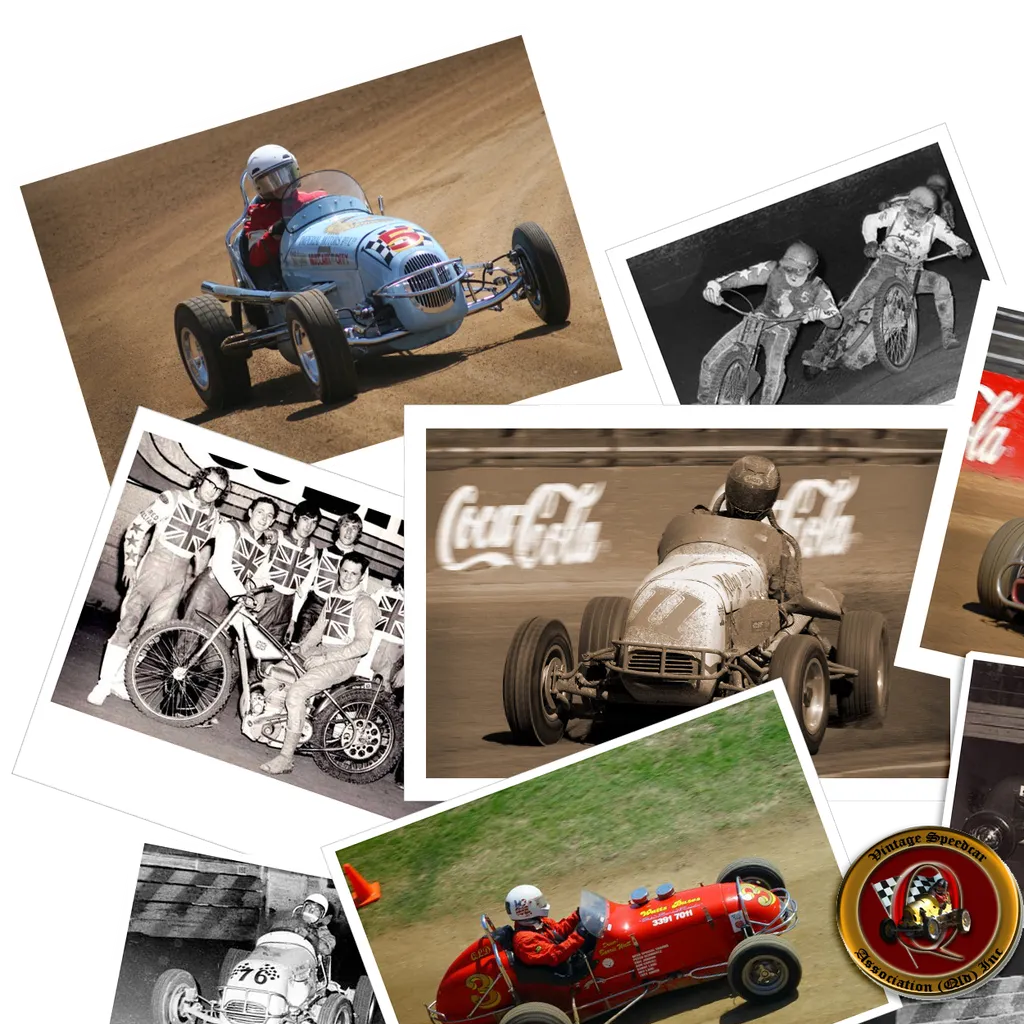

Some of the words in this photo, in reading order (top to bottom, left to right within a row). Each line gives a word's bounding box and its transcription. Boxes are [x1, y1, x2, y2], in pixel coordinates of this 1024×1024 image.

[378, 226, 424, 252] 5
[868, 833, 922, 862] Vintage
[926, 832, 987, 863] Speedcar
[652, 914, 673, 927] 3391
[674, 909, 694, 921] 7011
[239, 968, 267, 985] 76
[854, 948, 932, 993] Association
[978, 949, 1004, 974] Inc
[466, 973, 501, 1009] 3
